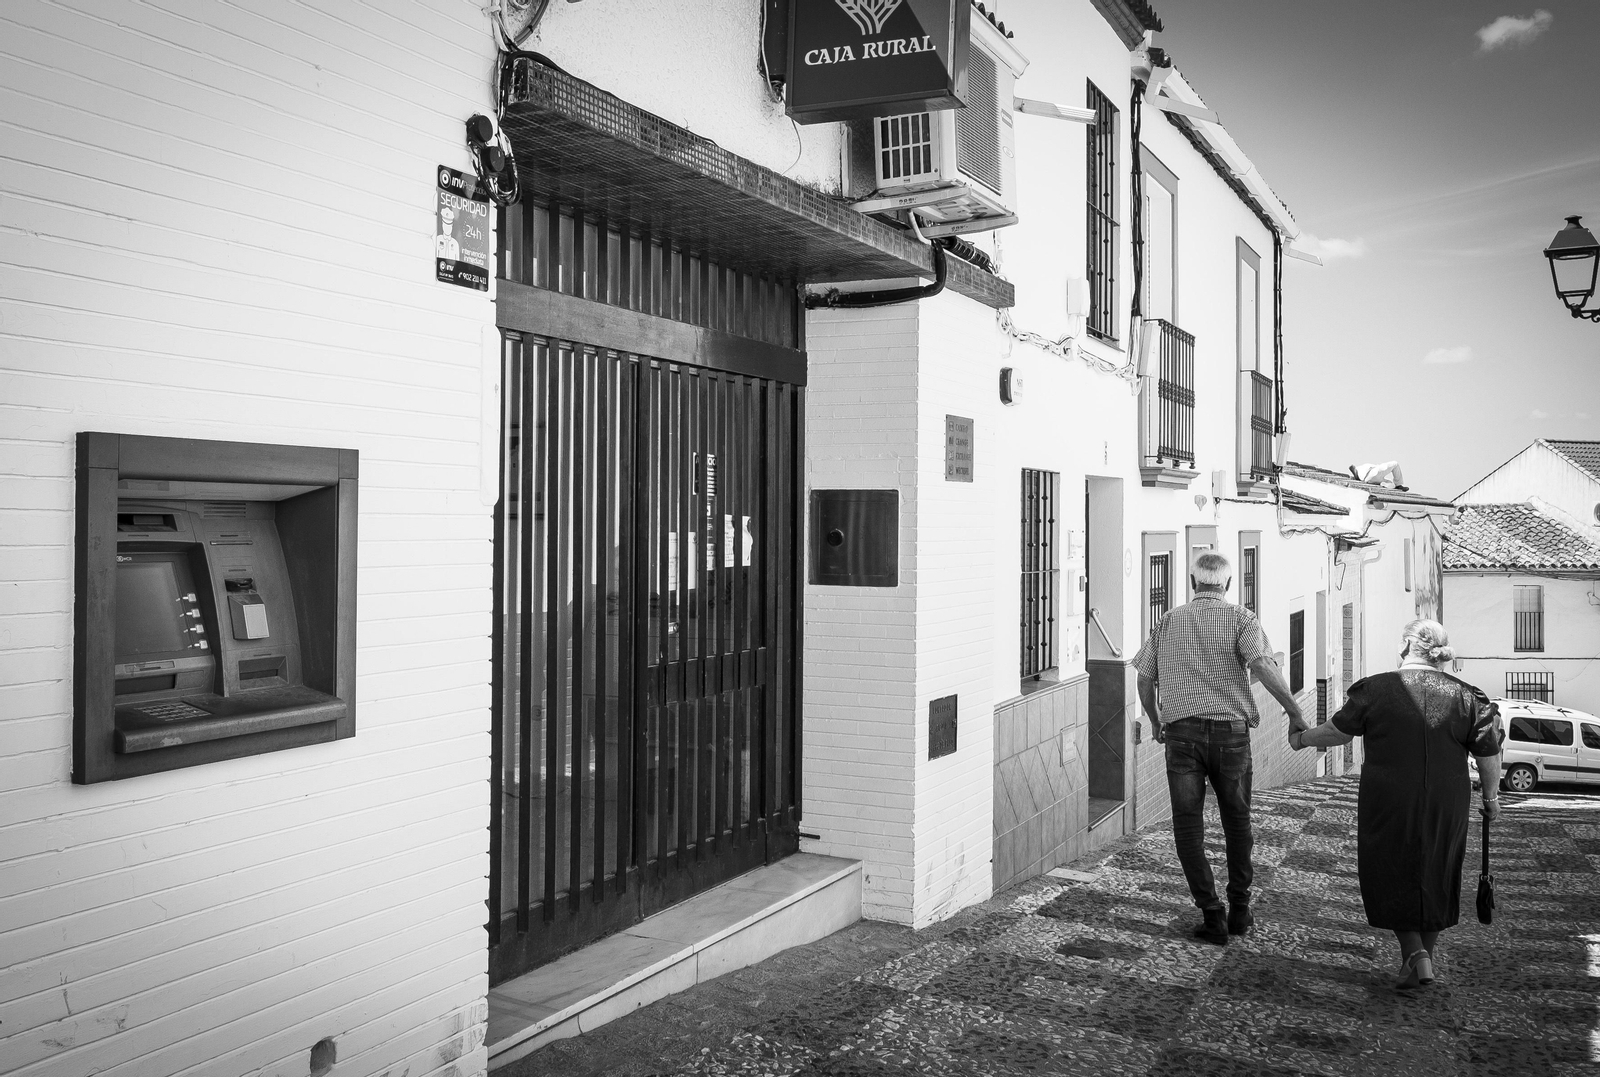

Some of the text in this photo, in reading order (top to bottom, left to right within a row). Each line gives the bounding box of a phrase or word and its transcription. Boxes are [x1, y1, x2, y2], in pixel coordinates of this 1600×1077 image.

[804, 35, 936, 66] CAJA RURAL
[440, 192, 487, 217] SEGURIDAD
[465, 224, 482, 240] 24h
